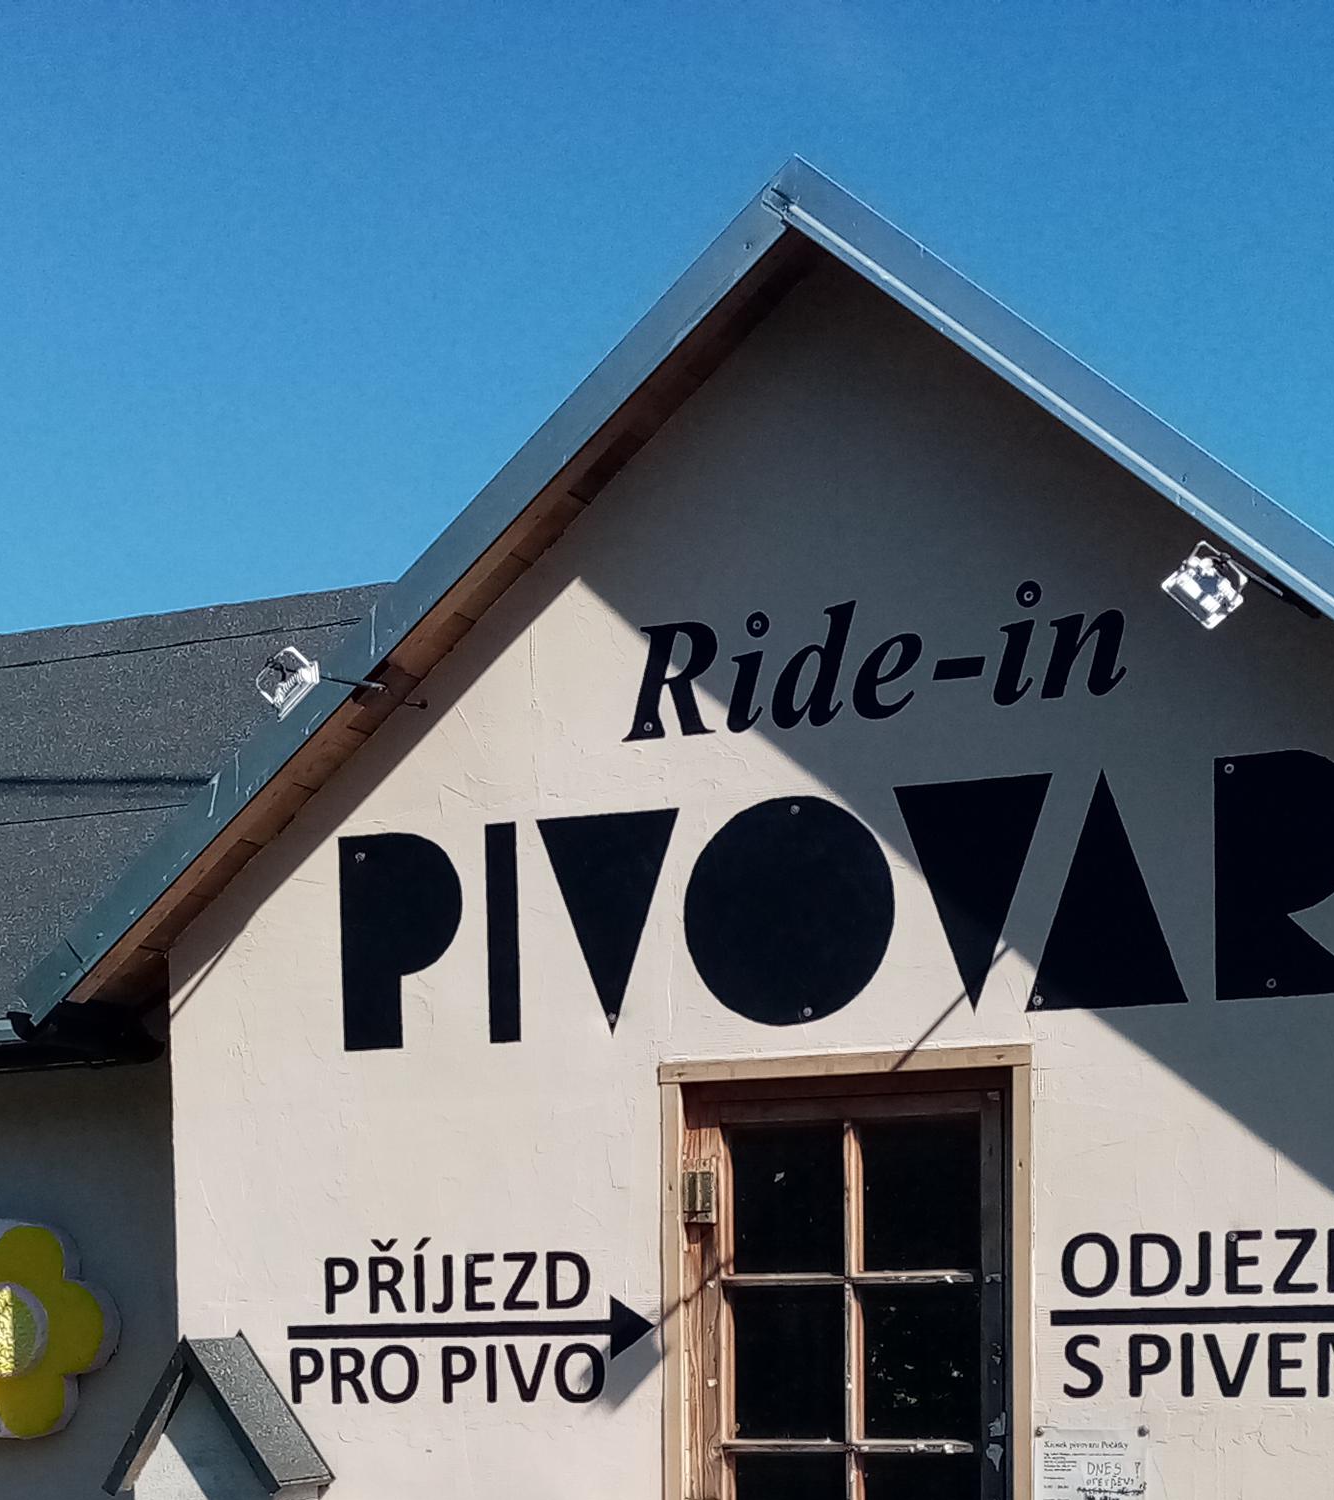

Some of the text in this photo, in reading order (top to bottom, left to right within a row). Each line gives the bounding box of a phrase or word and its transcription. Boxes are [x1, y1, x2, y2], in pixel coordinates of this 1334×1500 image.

[623, 579, 1127, 742] Ride-in
[324, 1237, 592, 1315] PŘÍJEZD
[289, 1342, 606, 1405] PRO PIVO
[1063, 1333, 1105, 1399] S
